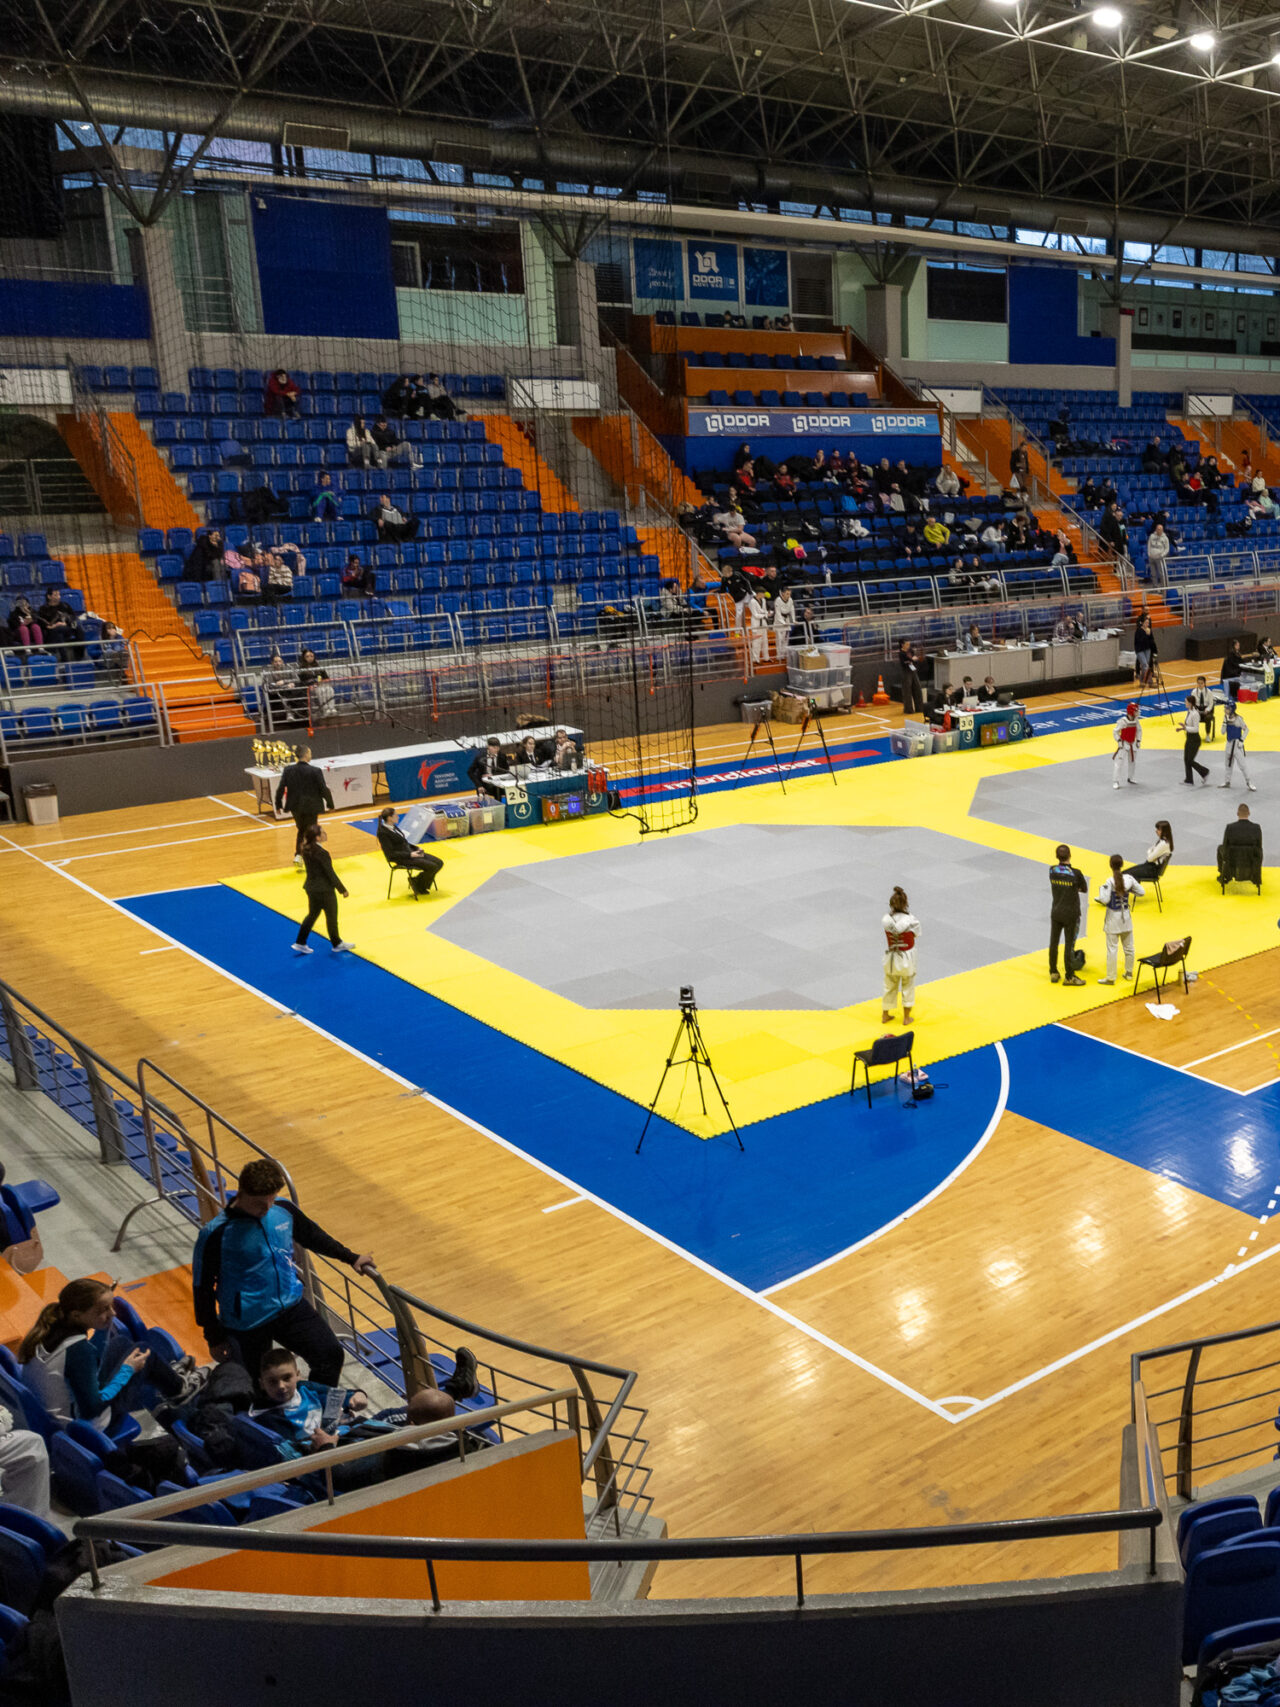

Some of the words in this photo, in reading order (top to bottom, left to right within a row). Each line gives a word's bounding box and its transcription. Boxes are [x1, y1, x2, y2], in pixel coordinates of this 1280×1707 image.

[692, 274, 723, 284] DDOR
[723, 415, 770, 427] DDOR
[809, 416, 851, 427] DDOR
[887, 416, 926, 427] DDOR
[664, 759, 823, 790] meridianbet
